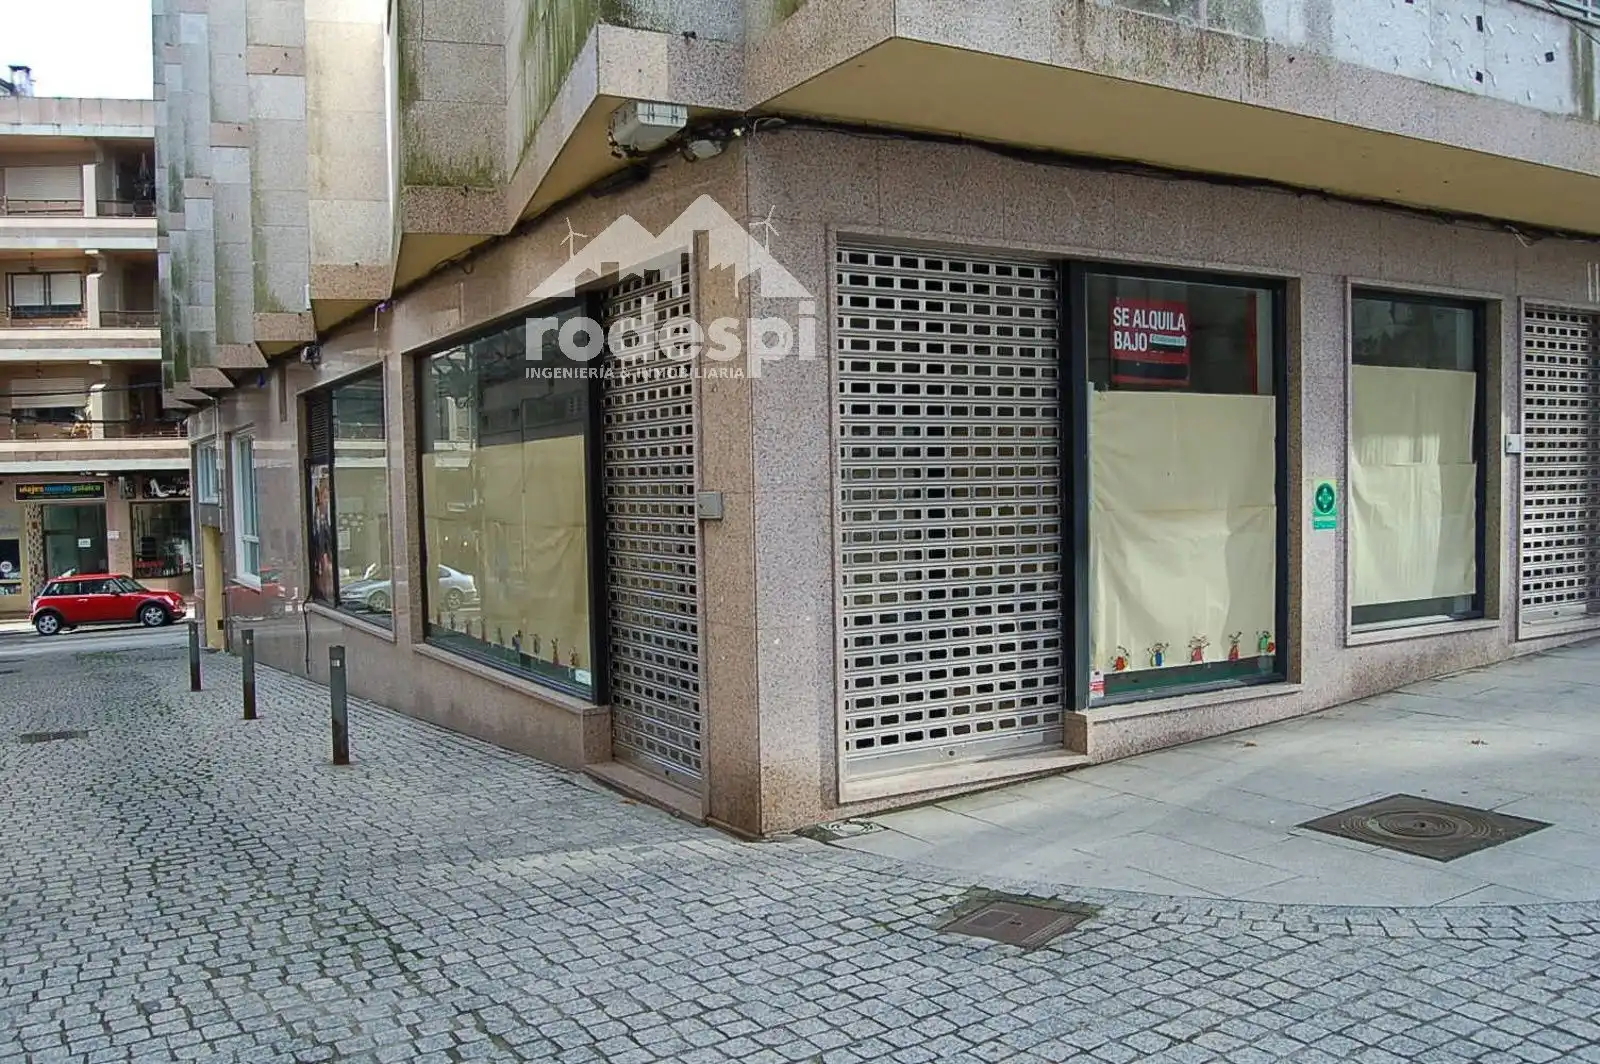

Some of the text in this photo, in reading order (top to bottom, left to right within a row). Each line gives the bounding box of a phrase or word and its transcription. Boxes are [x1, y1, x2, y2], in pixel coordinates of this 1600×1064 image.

[1113, 307, 1187, 331] SE ALQUILA
[1114, 330, 1148, 352] BAJO
